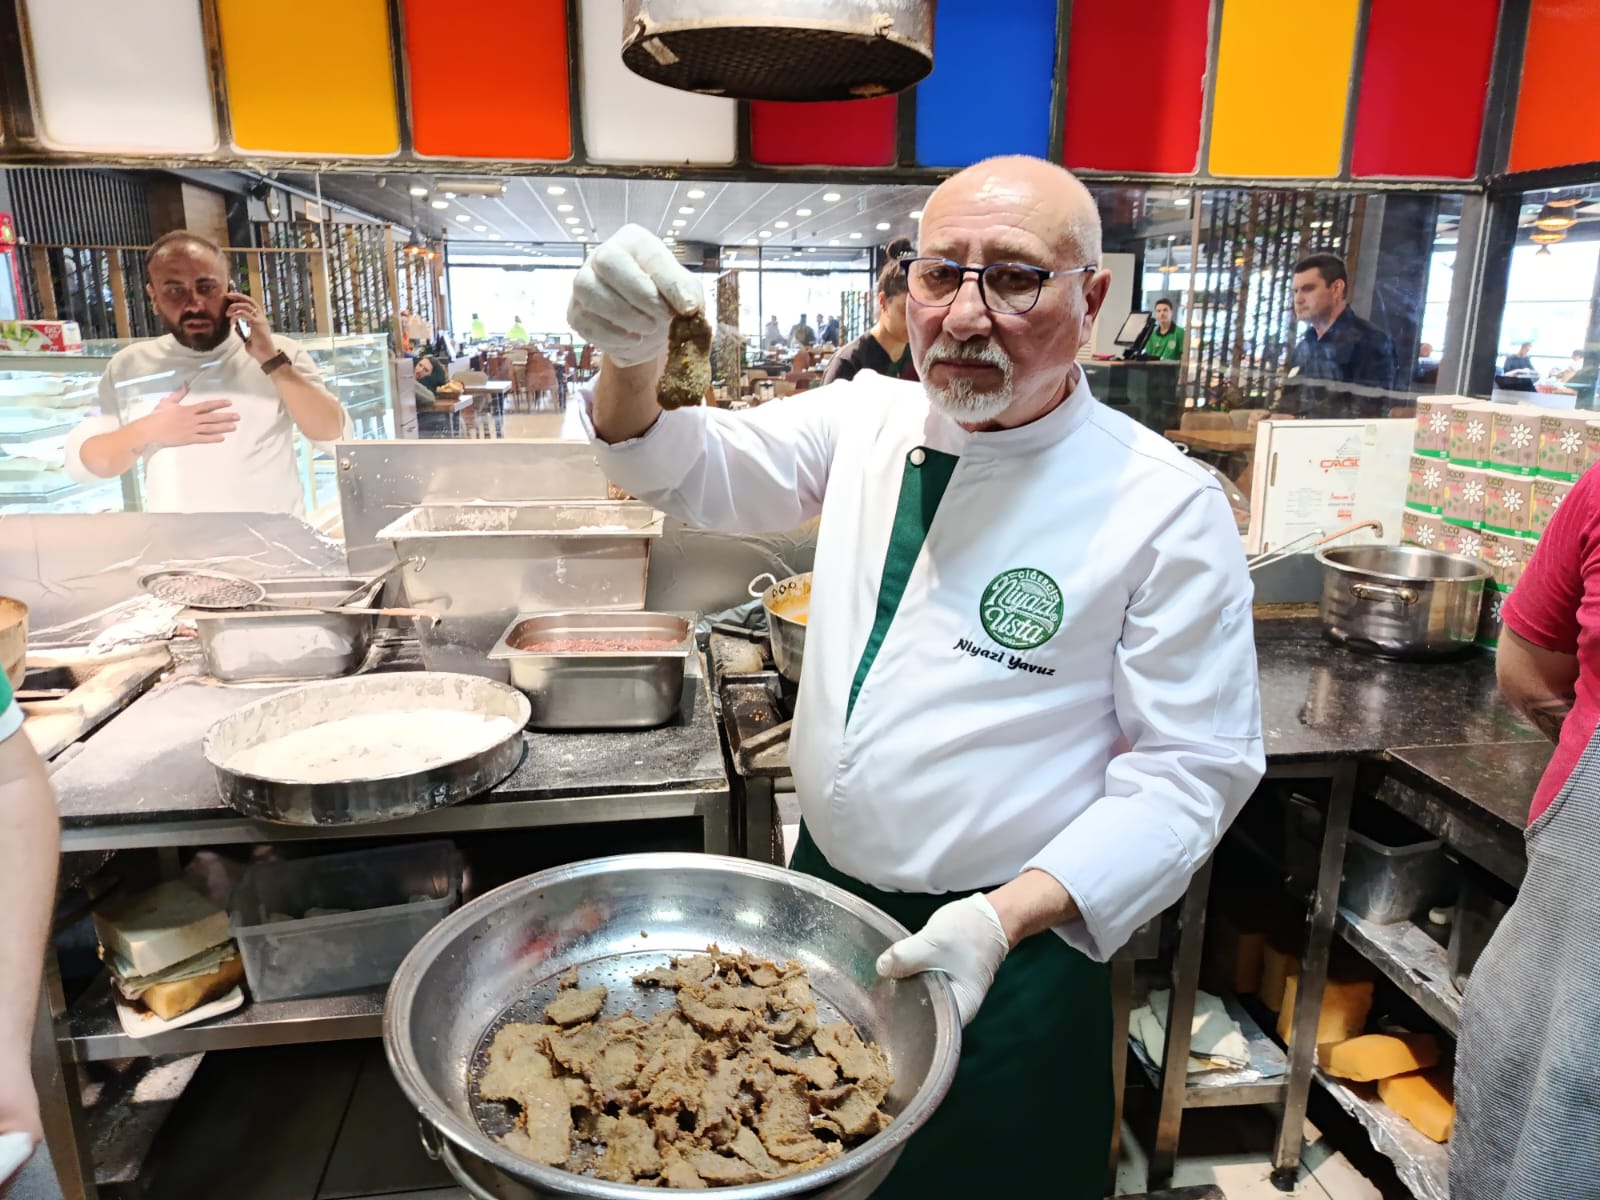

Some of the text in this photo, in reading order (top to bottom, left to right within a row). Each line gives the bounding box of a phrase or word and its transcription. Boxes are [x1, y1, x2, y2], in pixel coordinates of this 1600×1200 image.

[984, 576, 1058, 619] Niyazi
[984, 607, 1044, 644] Usta
[953, 638, 1056, 676] Niyazi Yavuz
